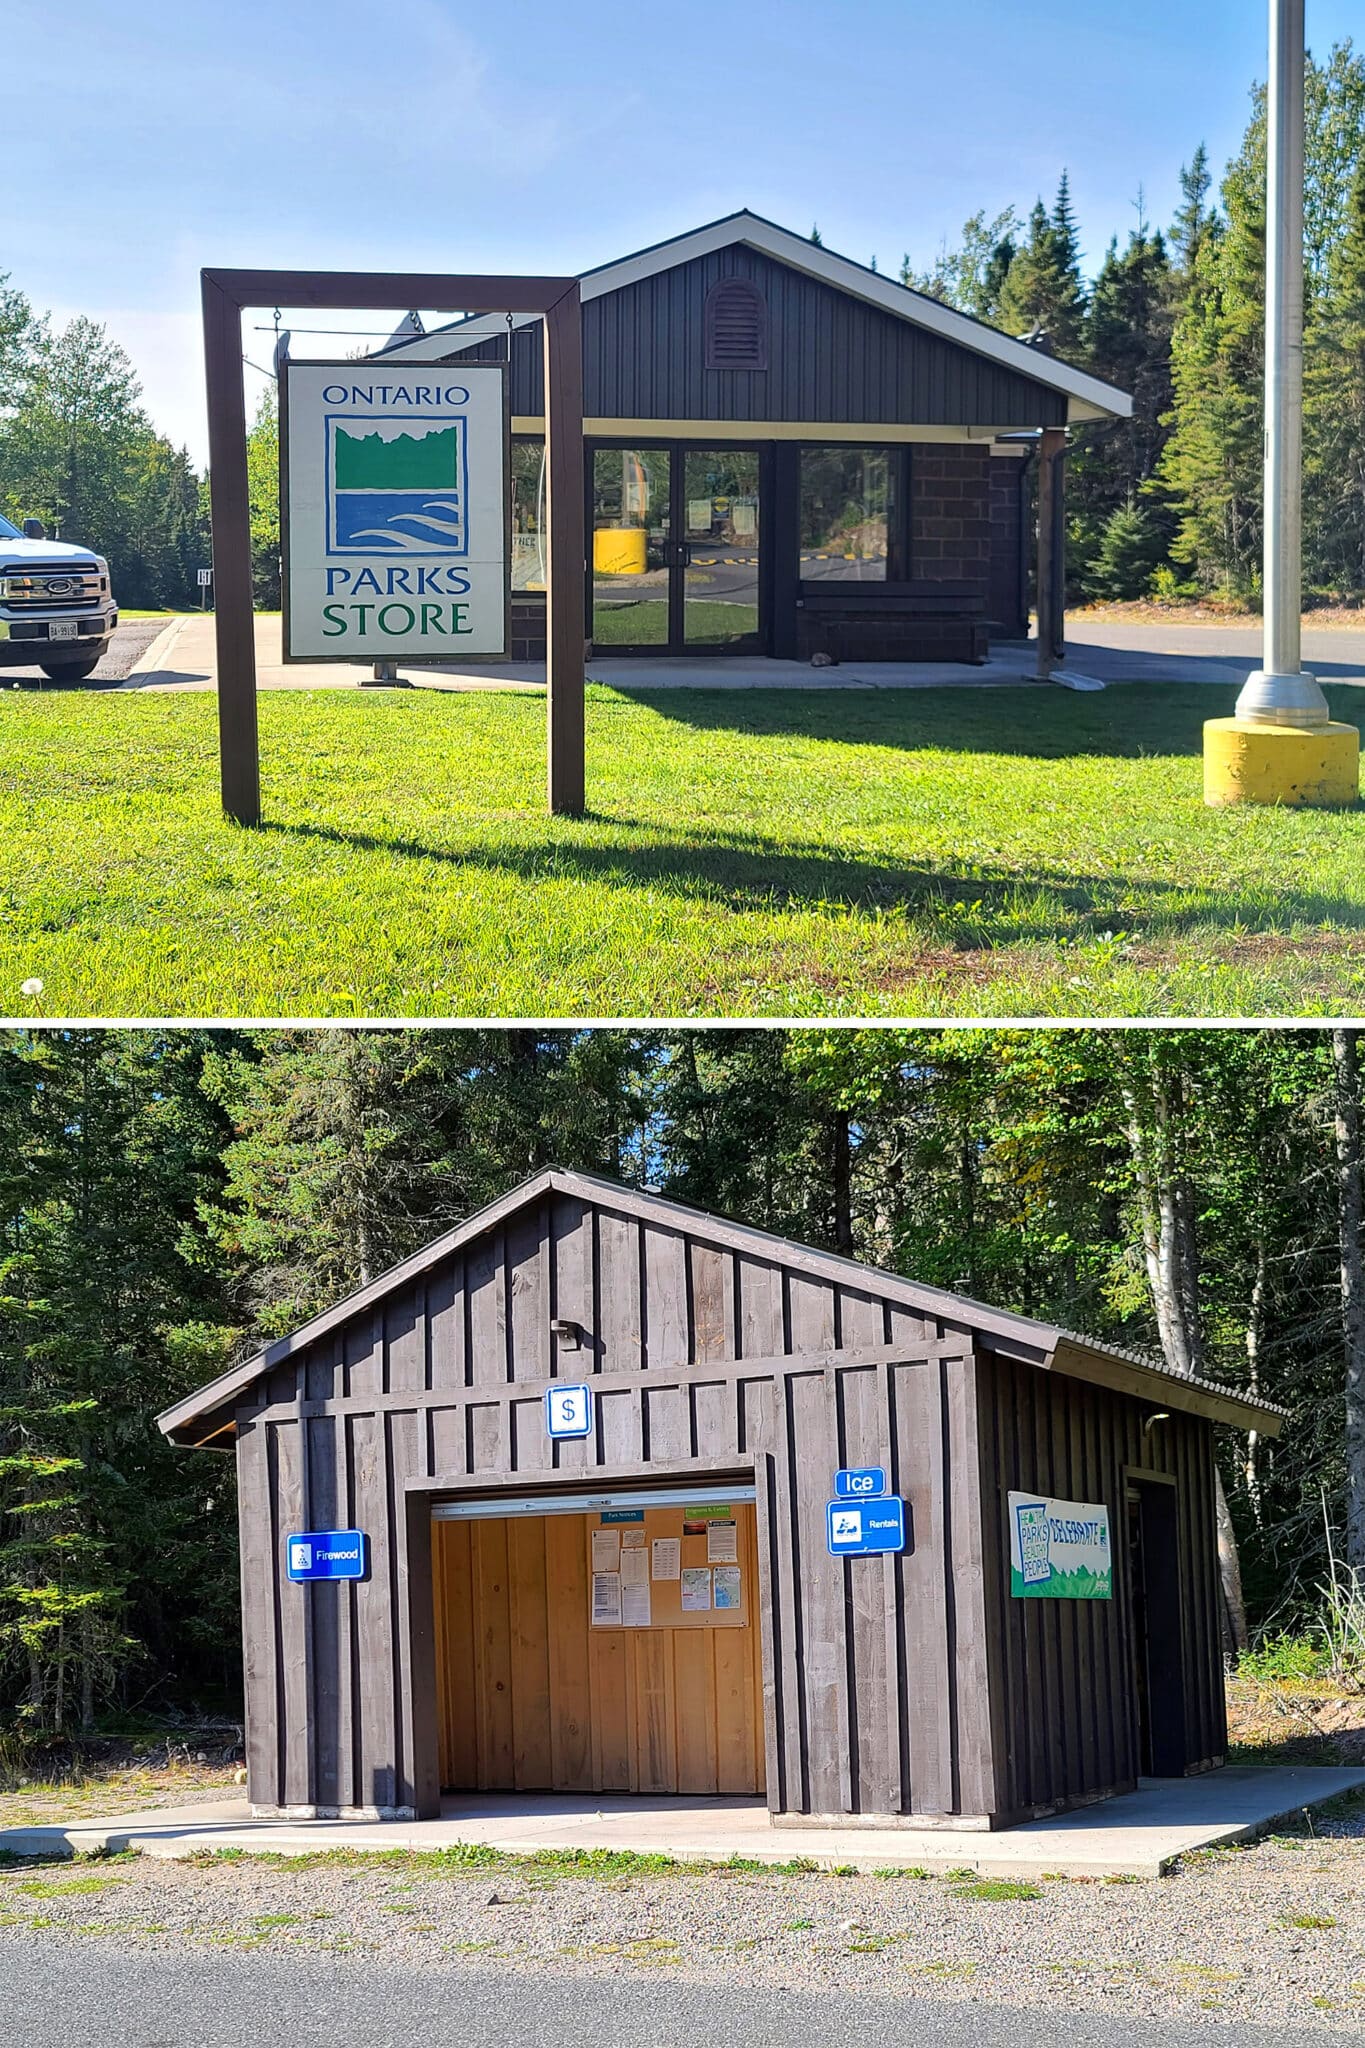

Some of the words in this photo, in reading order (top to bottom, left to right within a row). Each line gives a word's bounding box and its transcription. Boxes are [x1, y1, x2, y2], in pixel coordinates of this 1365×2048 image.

[322, 385, 470, 405] ONTARIO
[326, 566, 471, 596] PARKS
[322, 603, 473, 637] STORE
[846, 1473, 874, 1492] Ice
[869, 1519, 898, 1529] Rentals
[1050, 1518, 1098, 1546] CELEBRATE
[1022, 1525, 1047, 1544] PARKS
[316, 1547, 358, 1561] Firewood
[1024, 1558, 1049, 1577] PEOPLE
